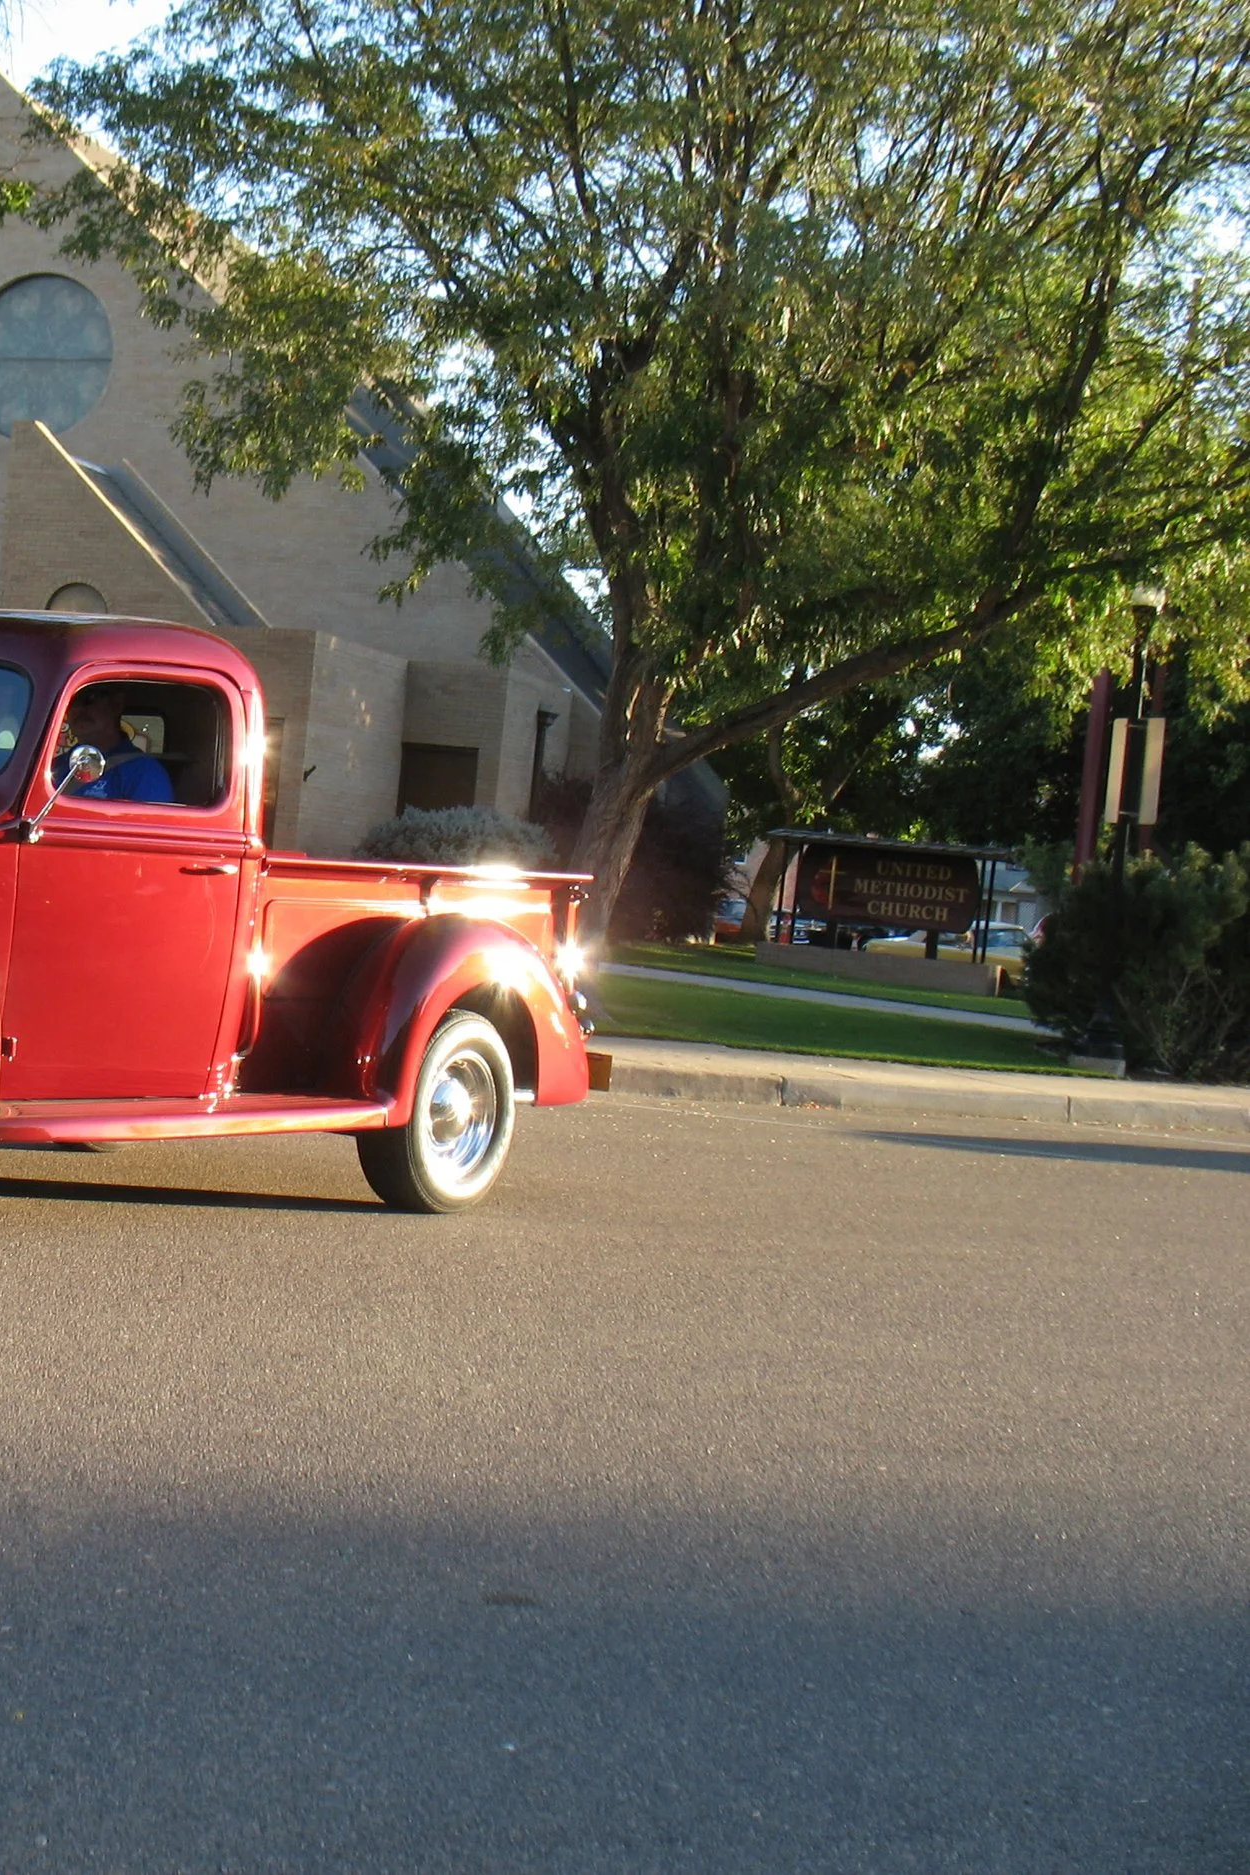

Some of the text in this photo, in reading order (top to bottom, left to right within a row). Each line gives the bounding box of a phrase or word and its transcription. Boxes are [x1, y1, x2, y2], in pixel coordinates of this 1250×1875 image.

[876, 860, 952, 880] UNITED
[853, 878, 969, 903] METHODIST
[866, 900, 949, 921] CHURCH
